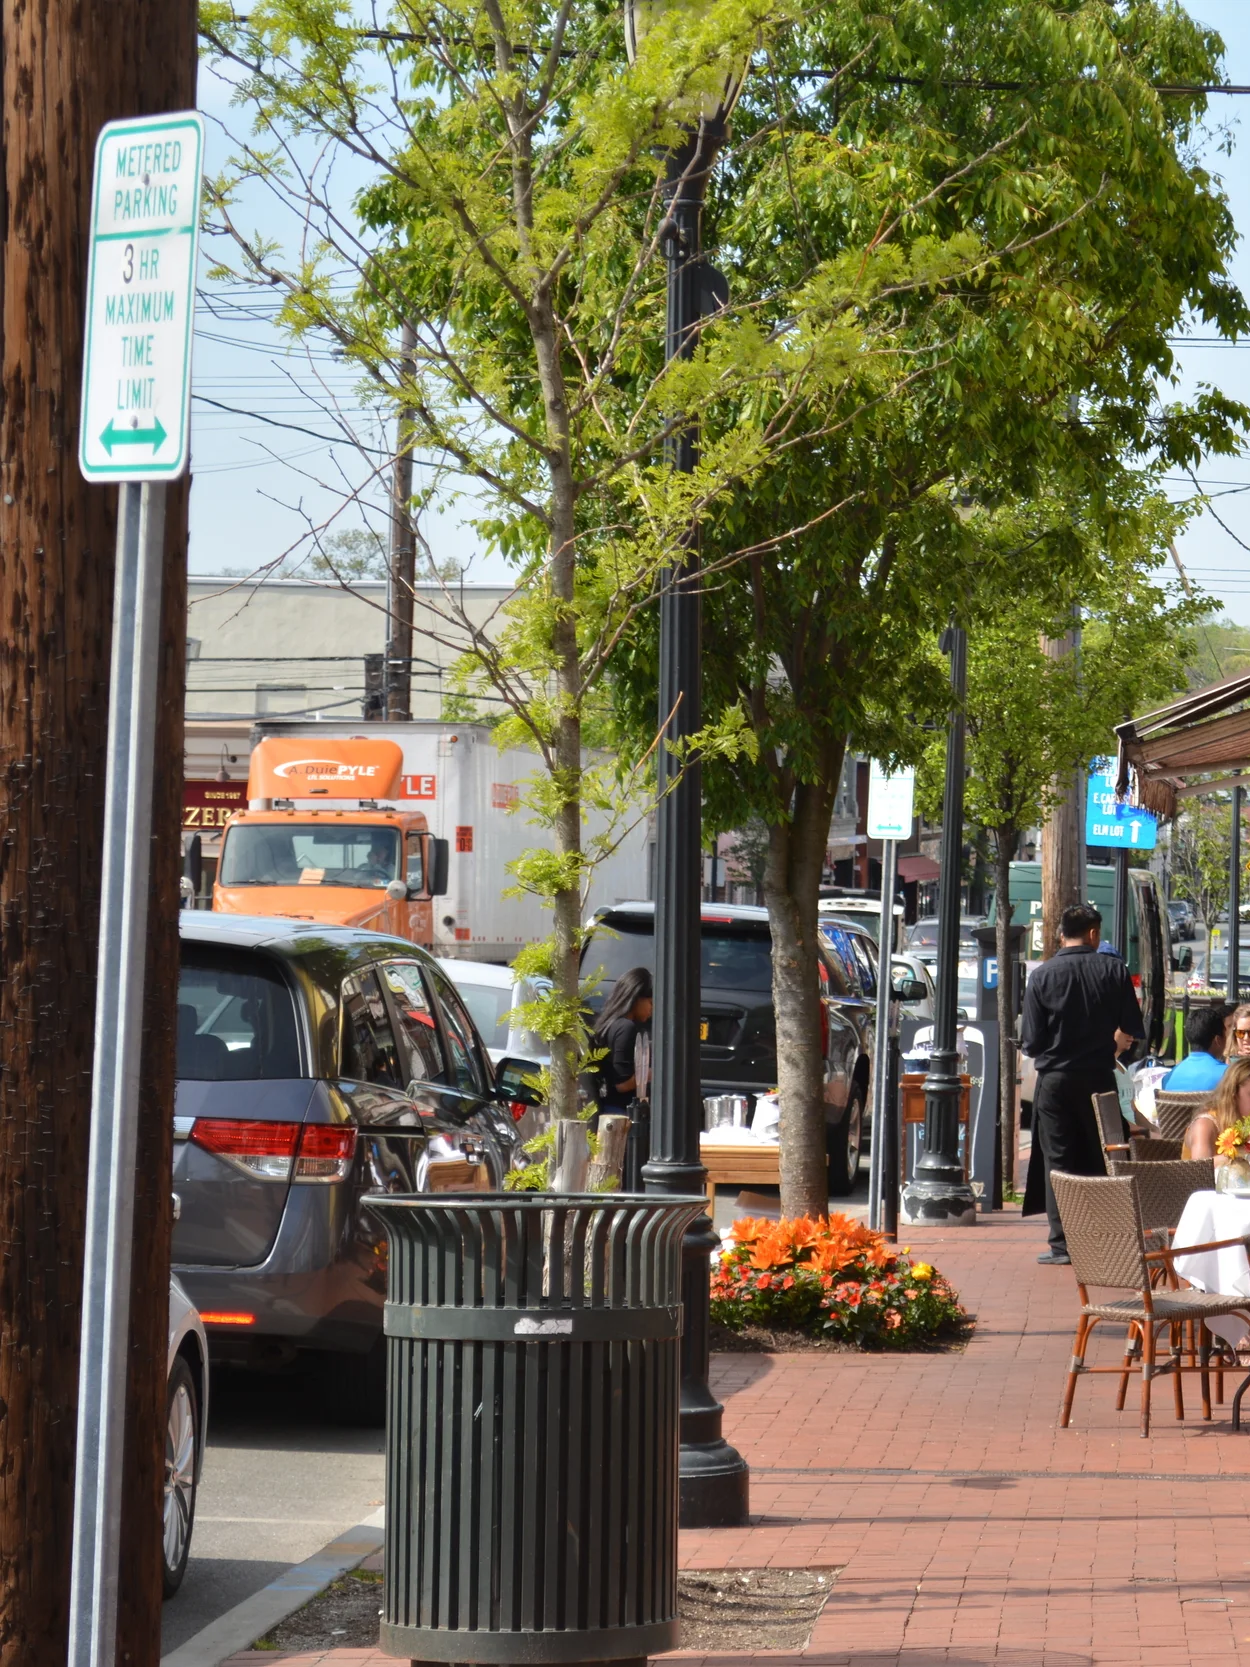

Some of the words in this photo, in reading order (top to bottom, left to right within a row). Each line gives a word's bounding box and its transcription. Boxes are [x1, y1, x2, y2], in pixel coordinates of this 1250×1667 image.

[116, 141, 181, 178] METERED
[114, 184, 178, 220] PARKING
[123, 243, 134, 284] 3
[139, 249, 160, 280] HR
[105, 291, 174, 325] MAXIMUM
[121, 334, 155, 367] TIME
[117, 377, 155, 410] LIMIT
[1102, 804, 1117, 816] LOT
[1093, 824, 1109, 836] ELM
[1110, 825, 1125, 837] LOT
[986, 960, 998, 983] P
